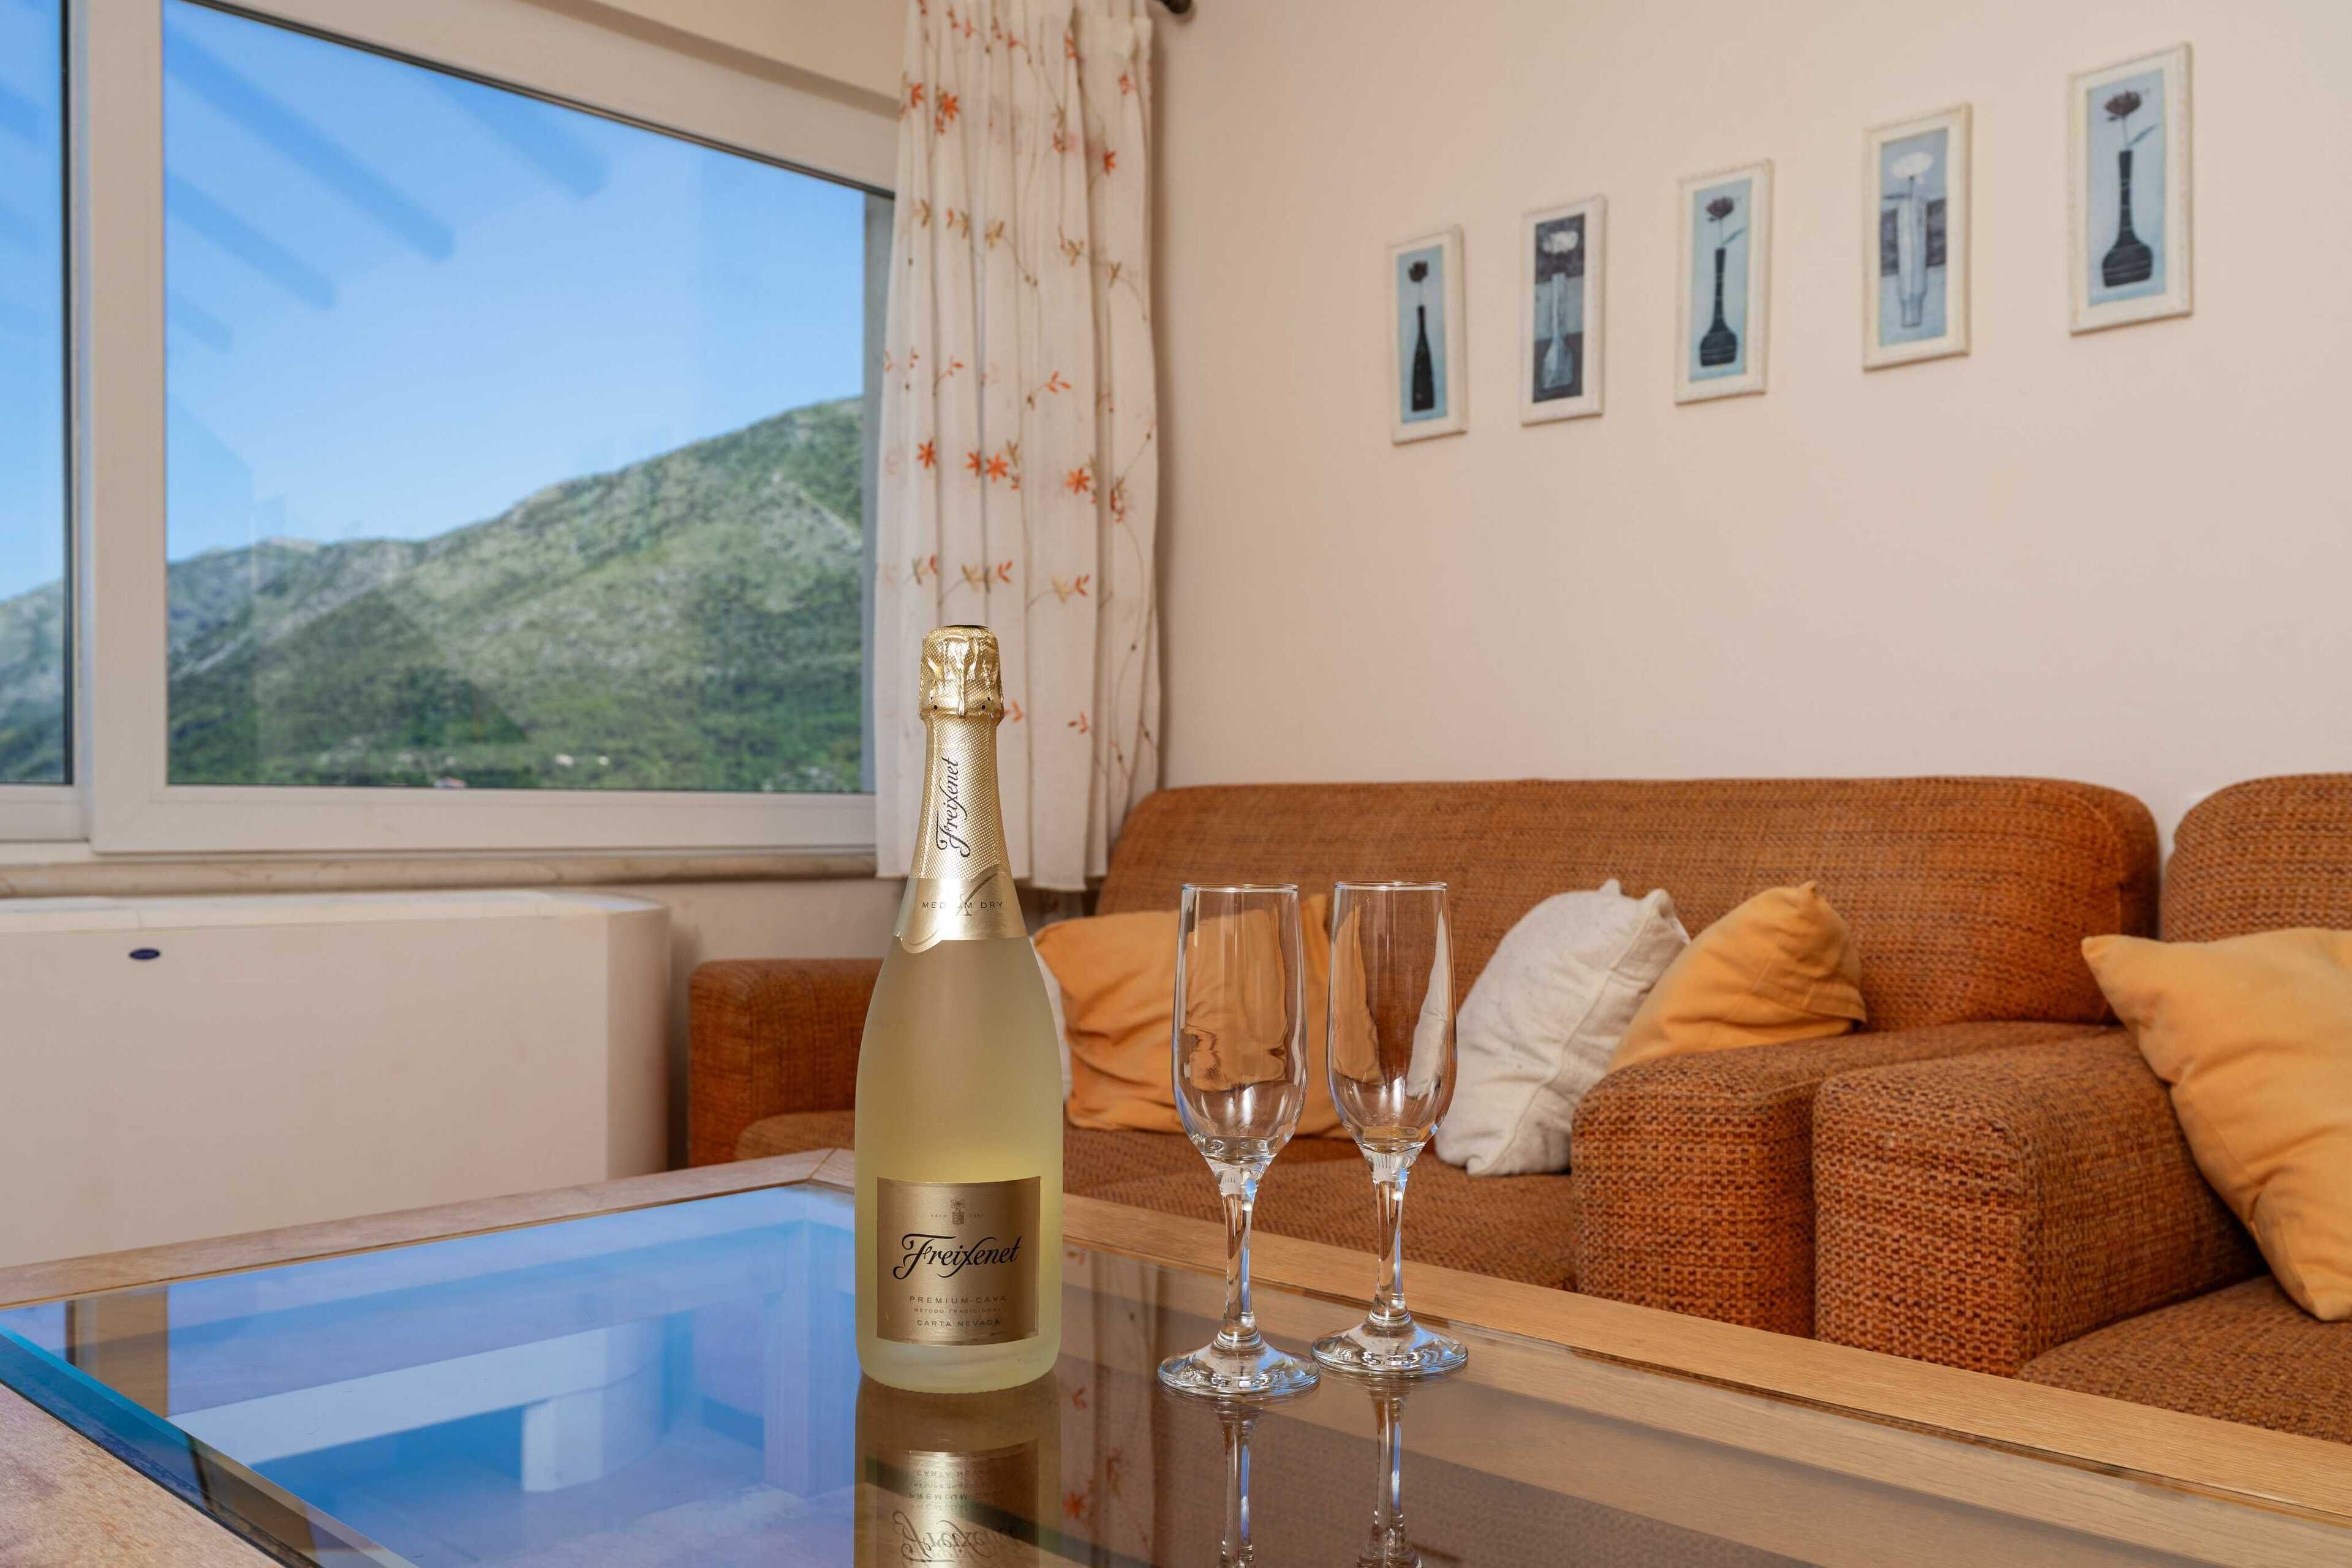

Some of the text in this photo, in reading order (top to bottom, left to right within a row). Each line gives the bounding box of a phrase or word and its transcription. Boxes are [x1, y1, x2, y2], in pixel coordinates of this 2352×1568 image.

[935, 756, 971, 858] Freixenet
[892, 1233, 1022, 1280] Freixenet
[957, 1318, 1001, 1327] NEVADA
